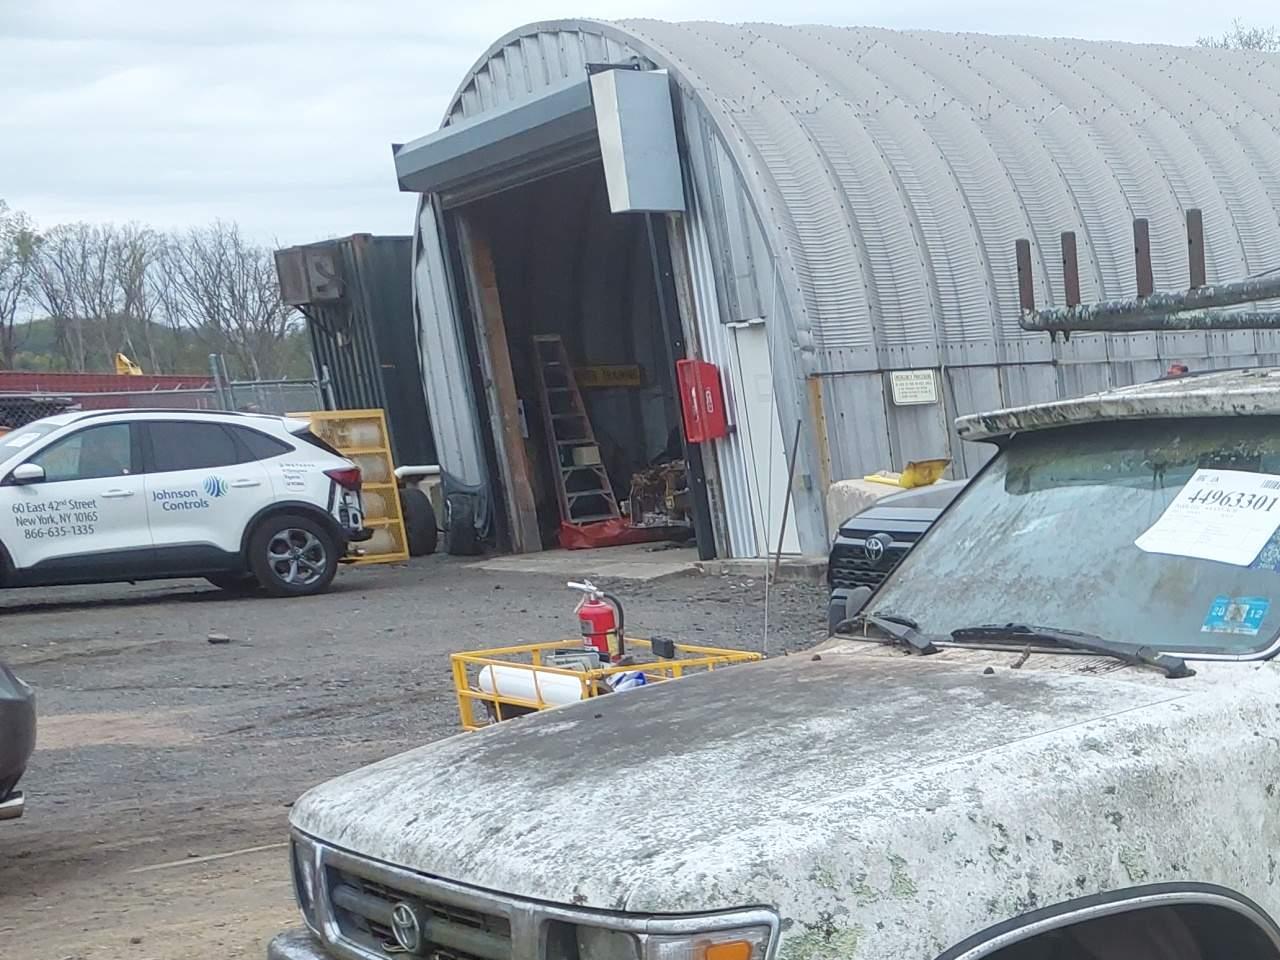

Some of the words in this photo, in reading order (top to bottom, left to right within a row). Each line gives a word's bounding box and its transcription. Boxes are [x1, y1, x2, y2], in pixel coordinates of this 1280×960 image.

[152, 490, 198, 502] Johnson
[1188, 488, 1279, 512] 44963301
[12, 503, 25, 513] 60
[26, 502, 47, 513] East
[69, 499, 97, 510] Street
[162, 498, 209, 511] Controls
[15, 516, 36, 527] New
[36, 514, 59, 525] York,
[59, 512, 72, 523] NY
[74, 511, 98, 522] 10165
[24, 524, 95, 539] 866-635-1335
